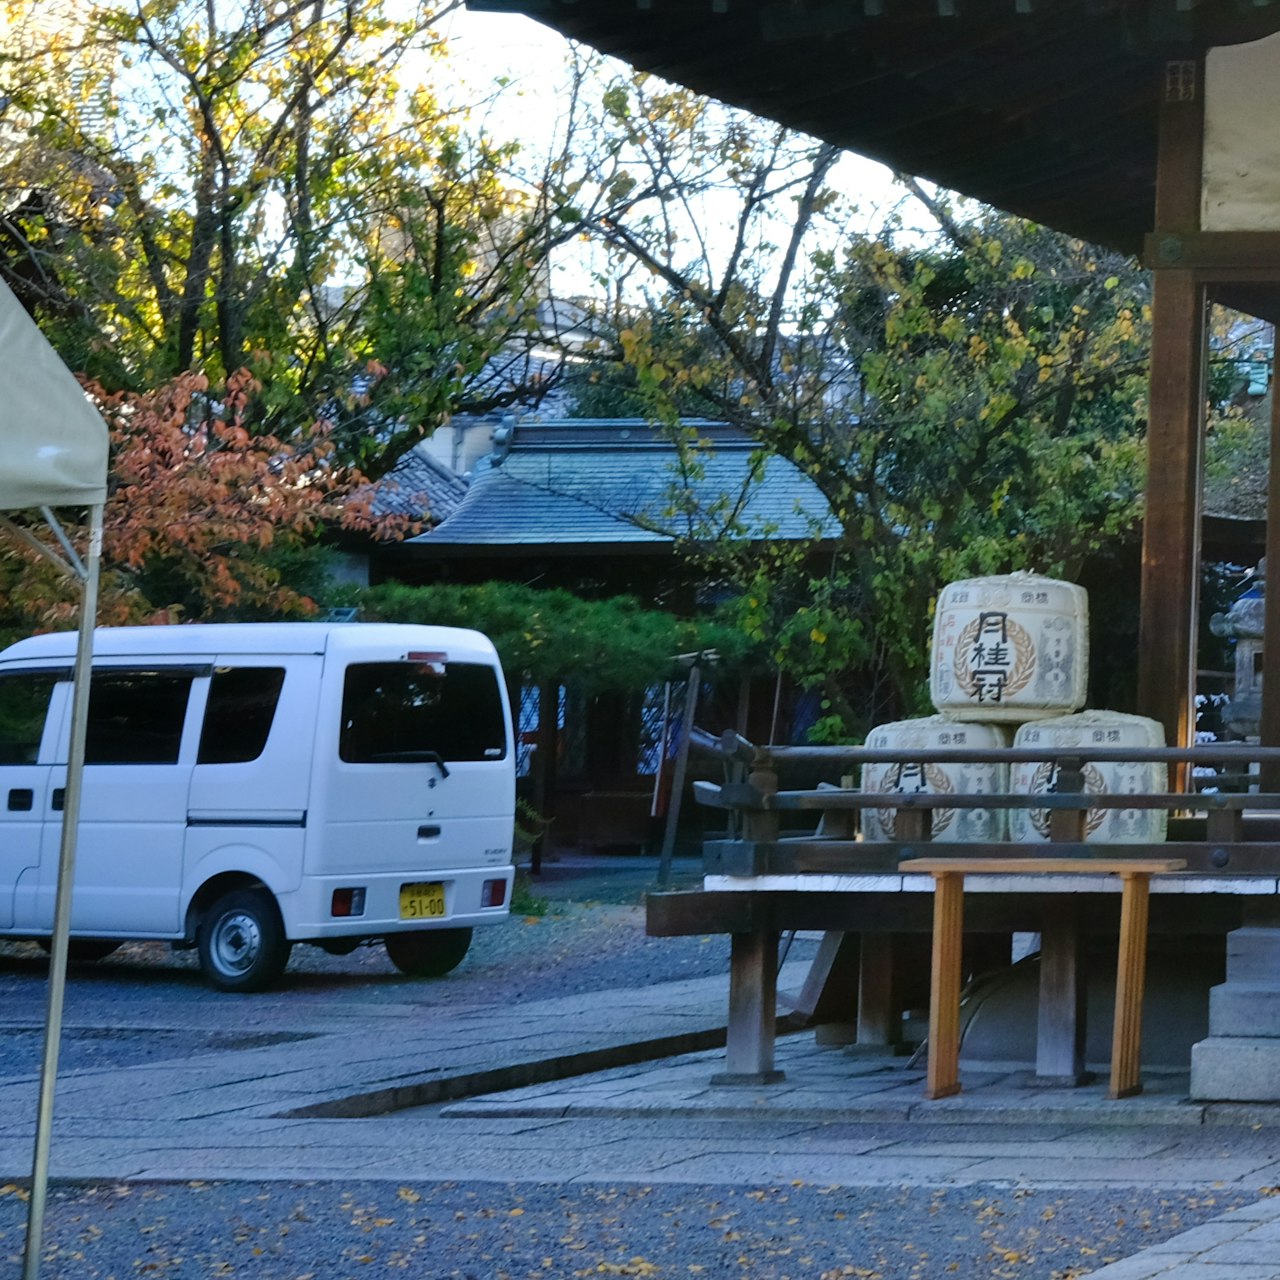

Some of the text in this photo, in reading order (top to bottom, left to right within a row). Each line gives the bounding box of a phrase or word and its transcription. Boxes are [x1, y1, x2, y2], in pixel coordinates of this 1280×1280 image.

[969, 610, 1011, 703] 月桂冠
[408, 897, 445, 917] 51-00
